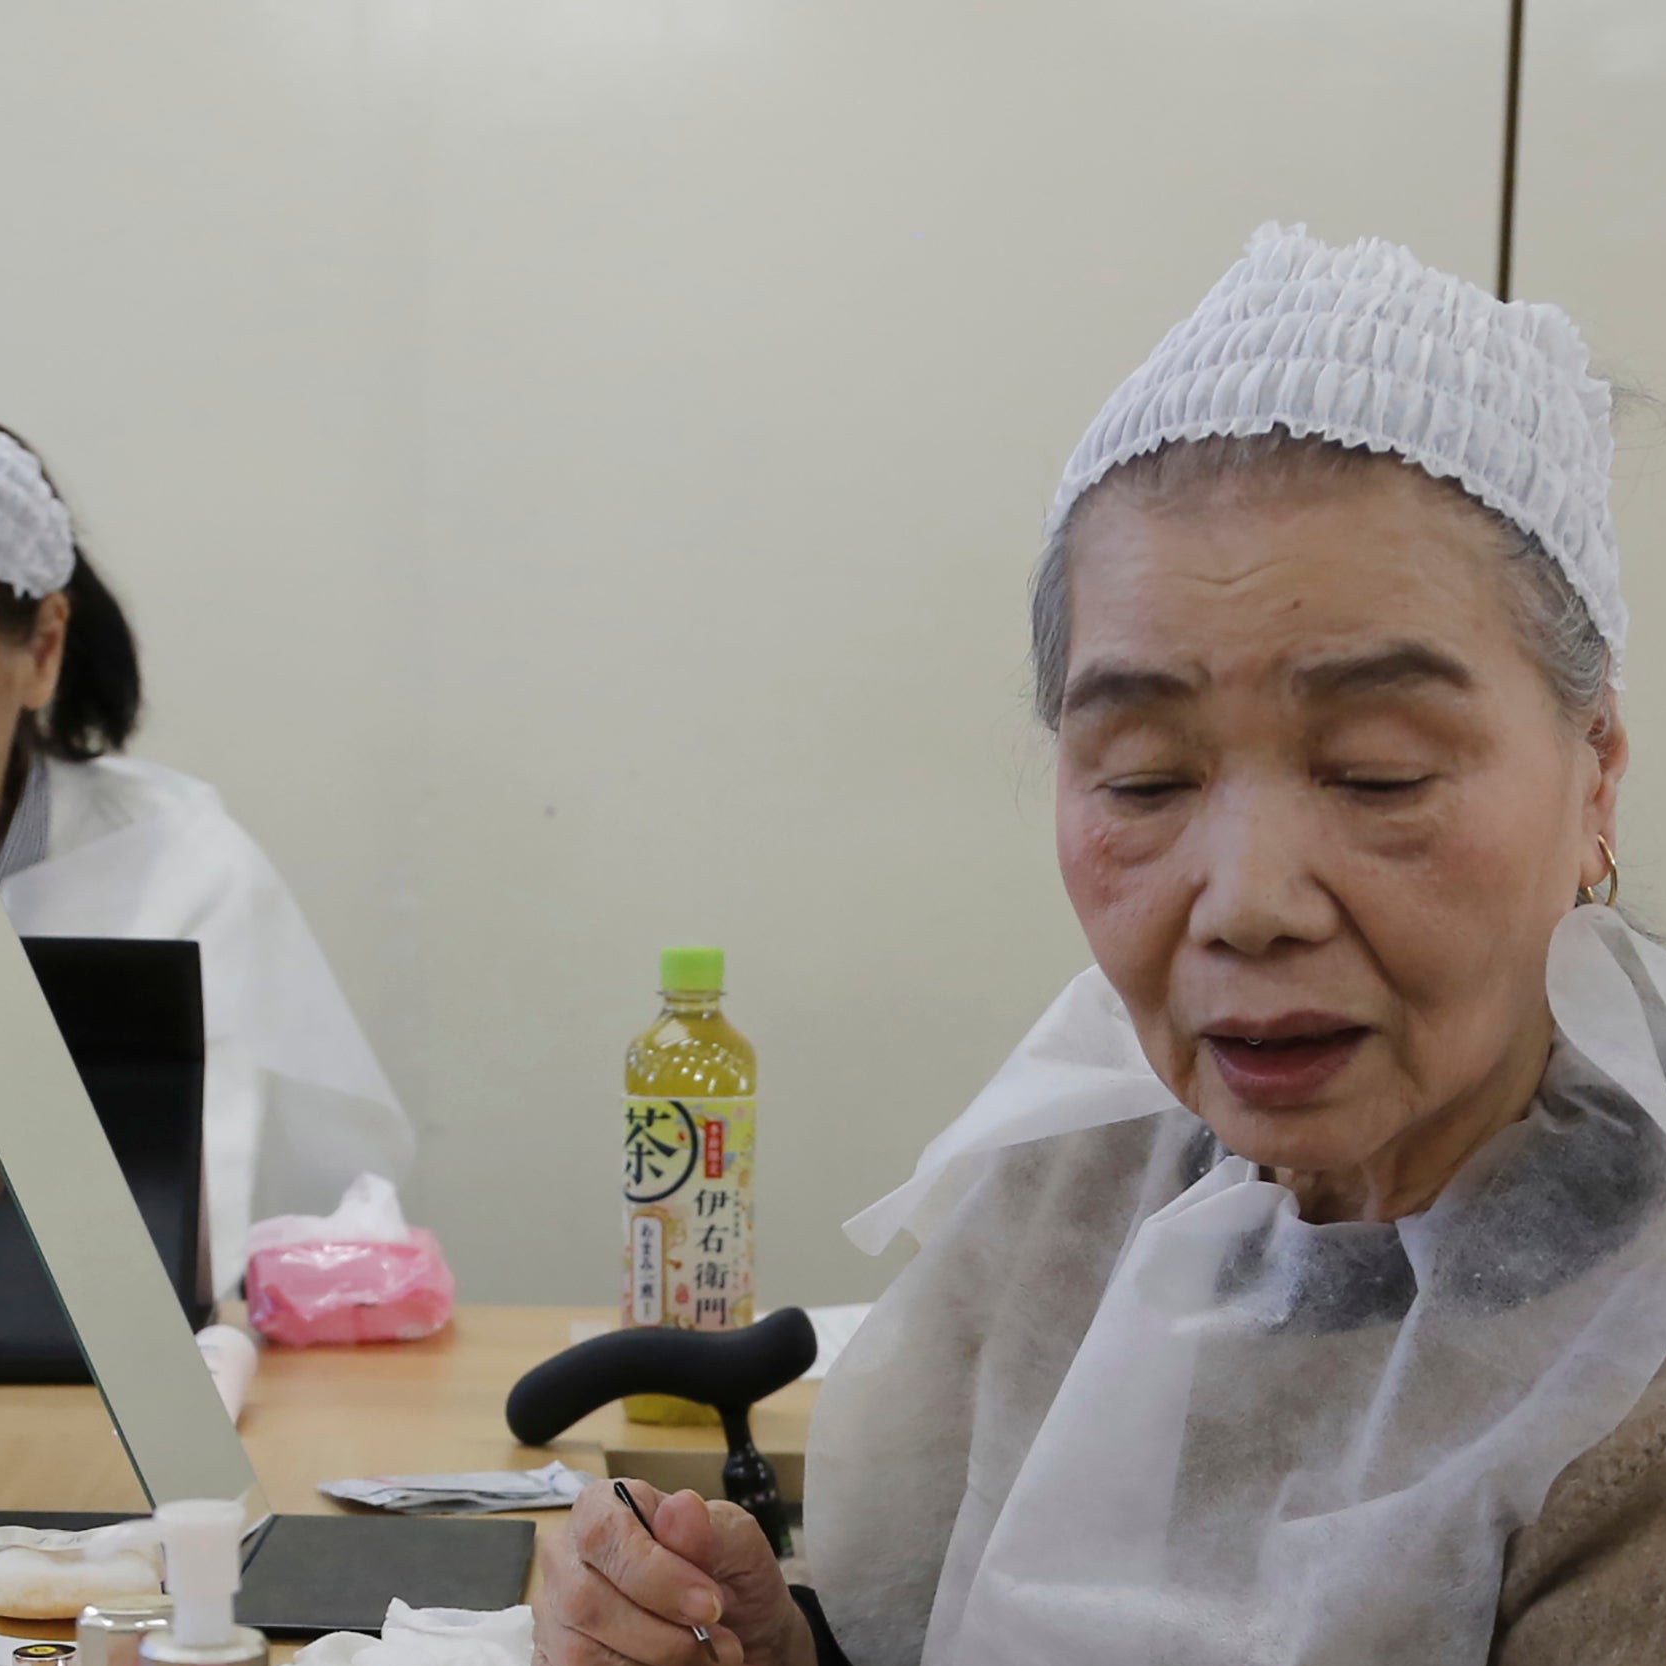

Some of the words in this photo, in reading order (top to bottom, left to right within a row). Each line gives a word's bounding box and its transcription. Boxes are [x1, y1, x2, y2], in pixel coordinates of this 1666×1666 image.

[625, 1106, 680, 1187] 茶
[694, 1188, 730, 1325] 伊右衛門
